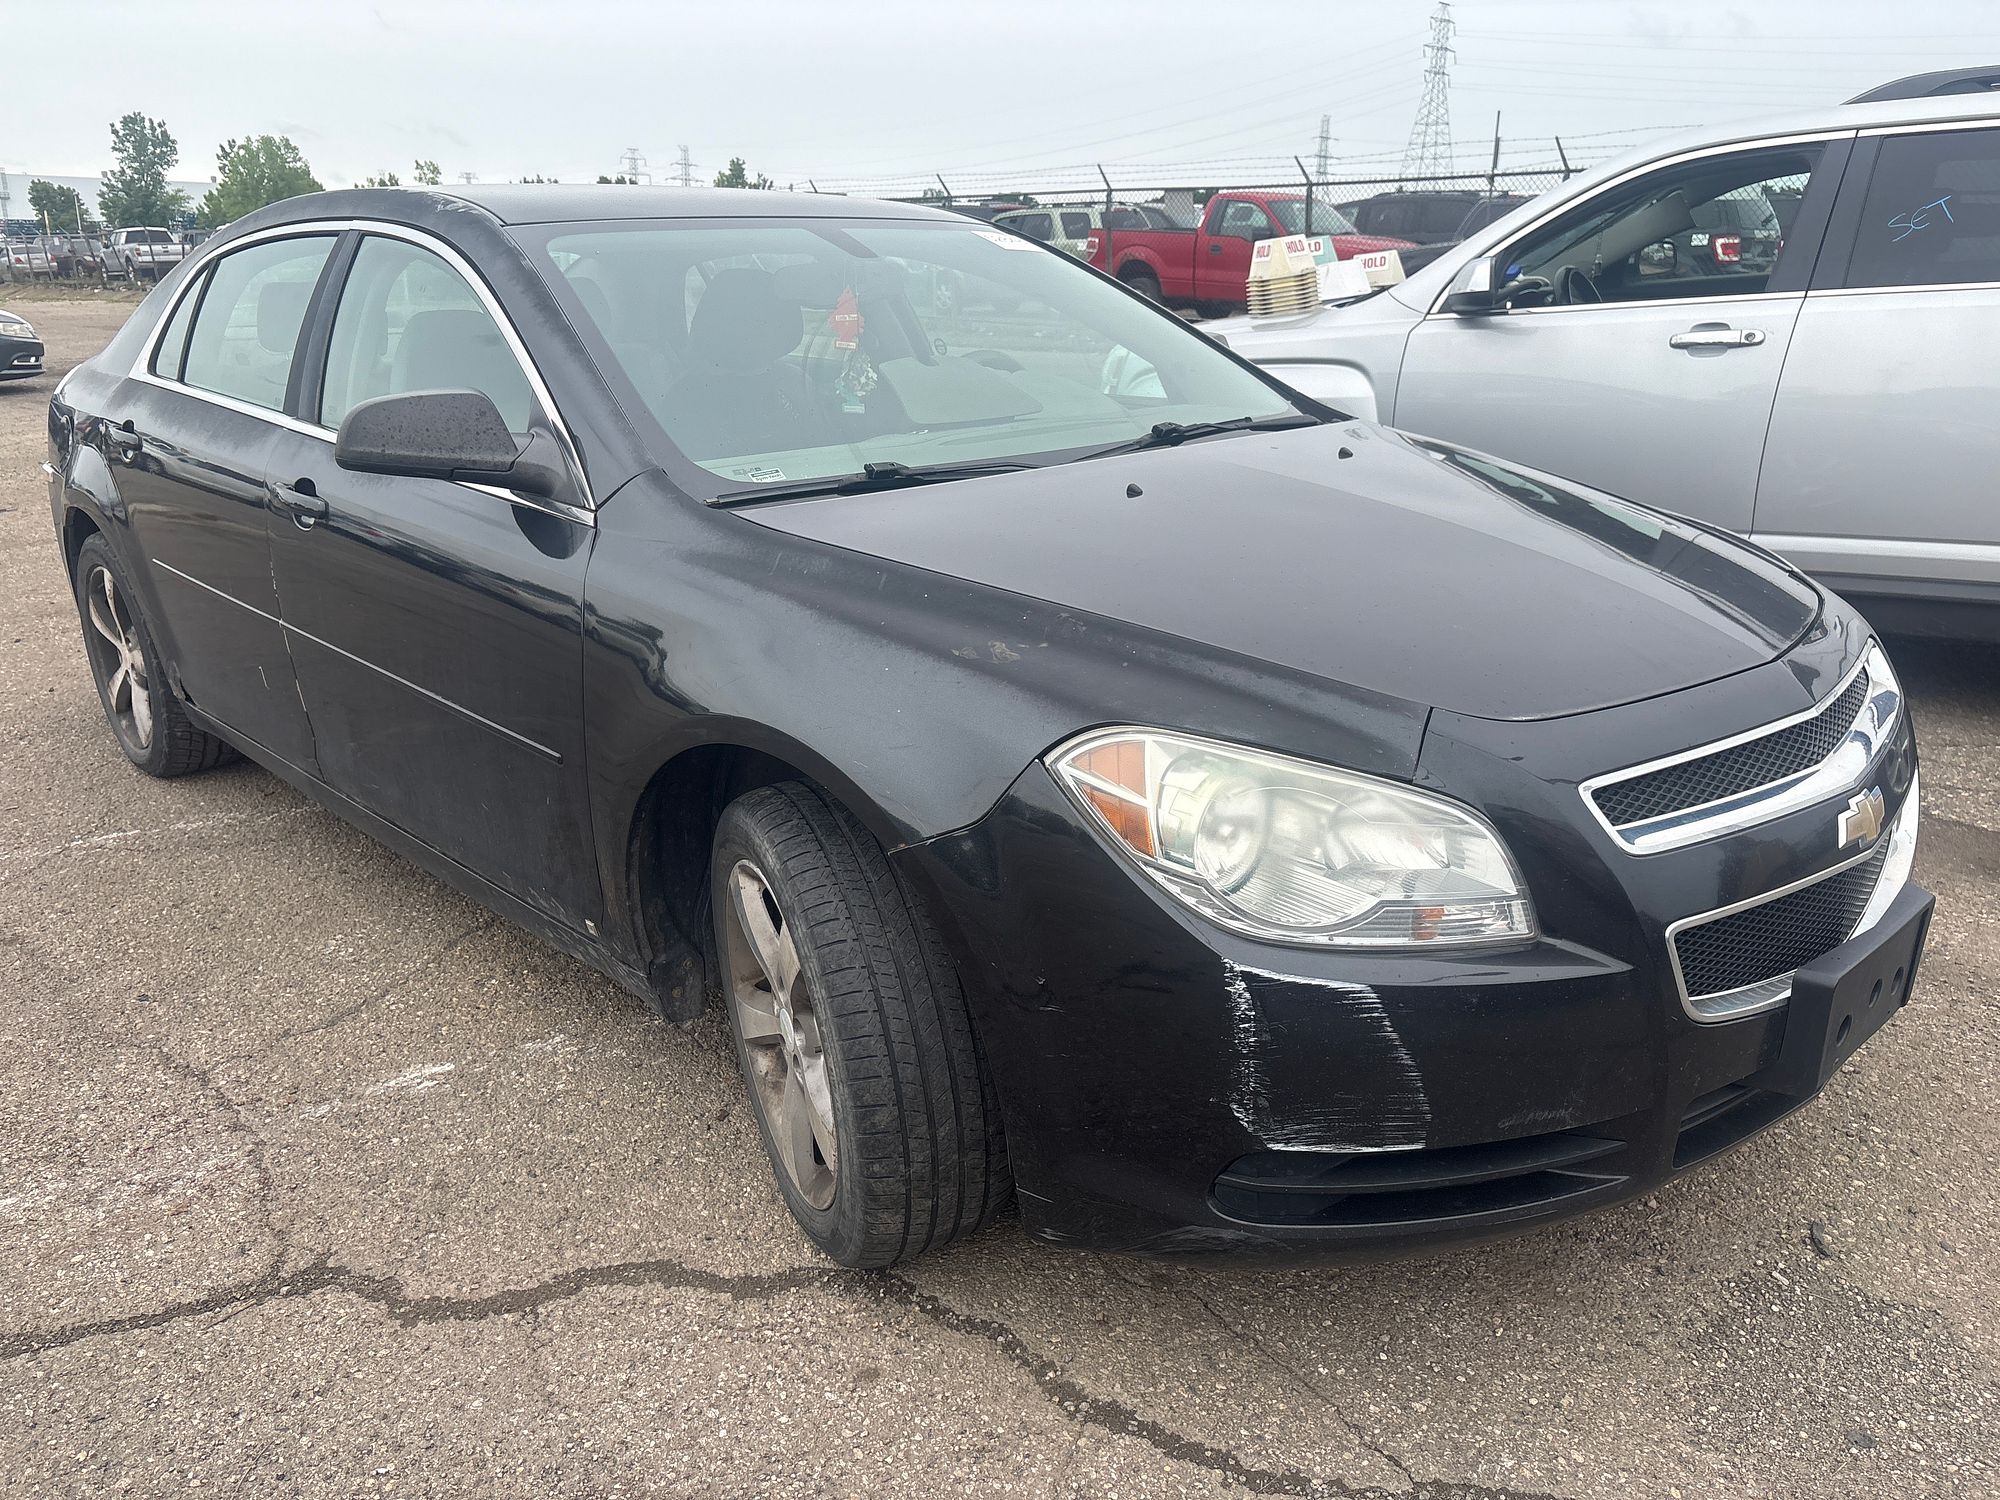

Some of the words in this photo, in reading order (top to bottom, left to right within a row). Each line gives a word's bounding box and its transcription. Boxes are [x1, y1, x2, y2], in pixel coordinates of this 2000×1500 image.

[1888, 195, 1953, 242] SET
[1256, 244, 1271, 258] HOLD
[1285, 239, 1305, 254] HOLD
[1308, 241, 1321, 253] LD
[1361, 256, 1386, 269] HOLD
